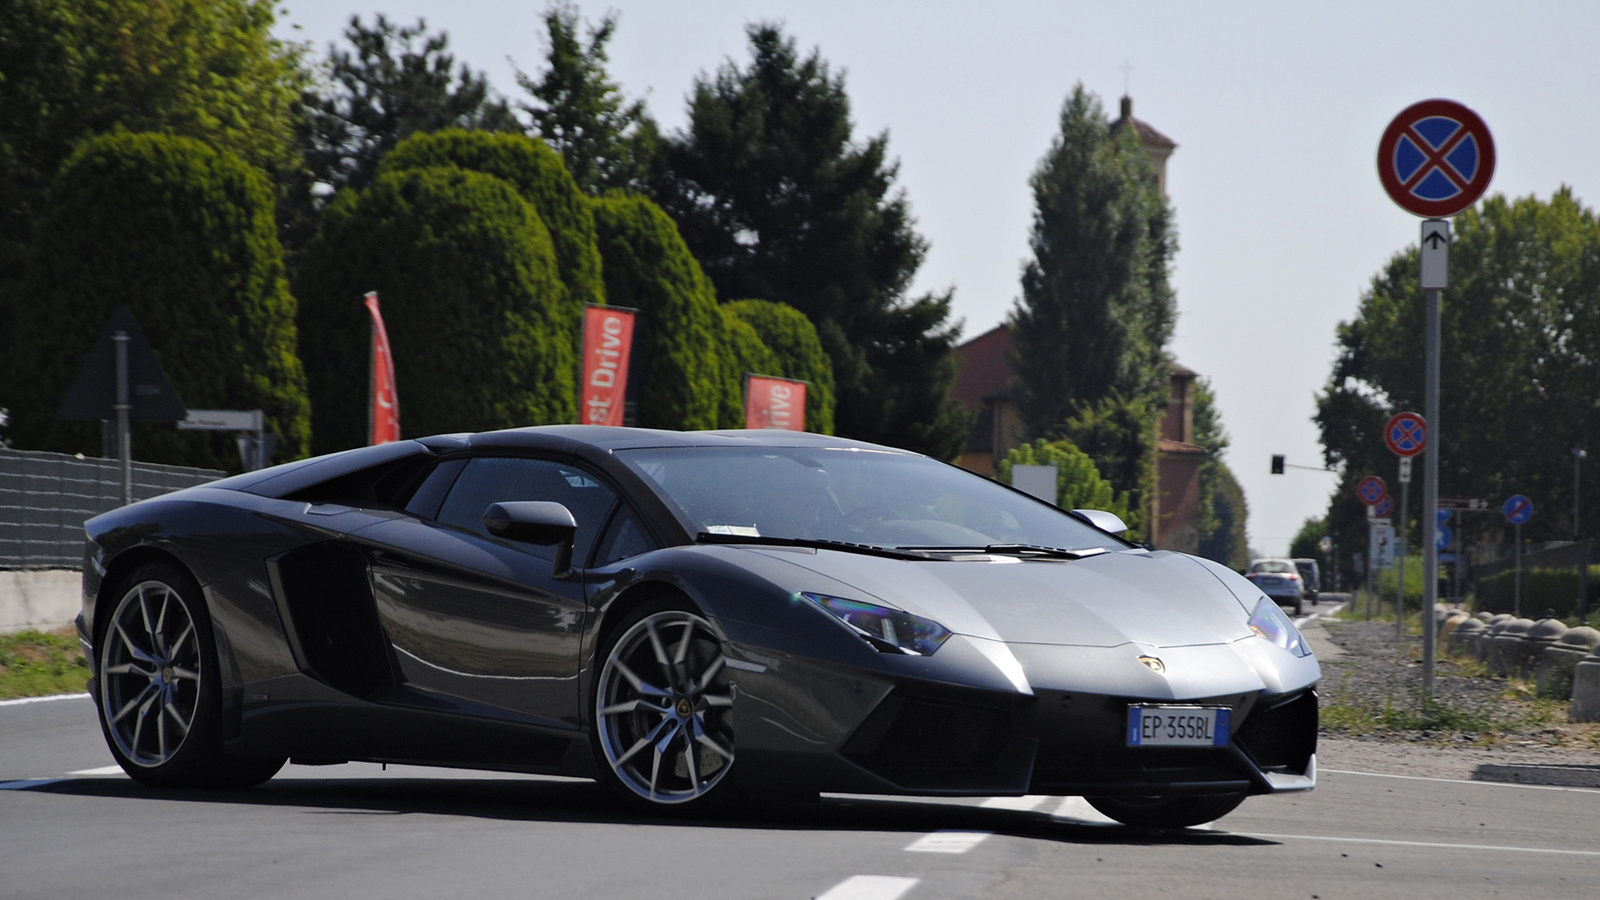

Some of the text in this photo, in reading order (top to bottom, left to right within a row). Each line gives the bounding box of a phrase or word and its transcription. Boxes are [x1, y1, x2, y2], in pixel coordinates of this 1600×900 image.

[588, 395, 612, 425] st
[762, 384, 791, 429] rive
[1142, 715, 1213, 740] EP 355BL
